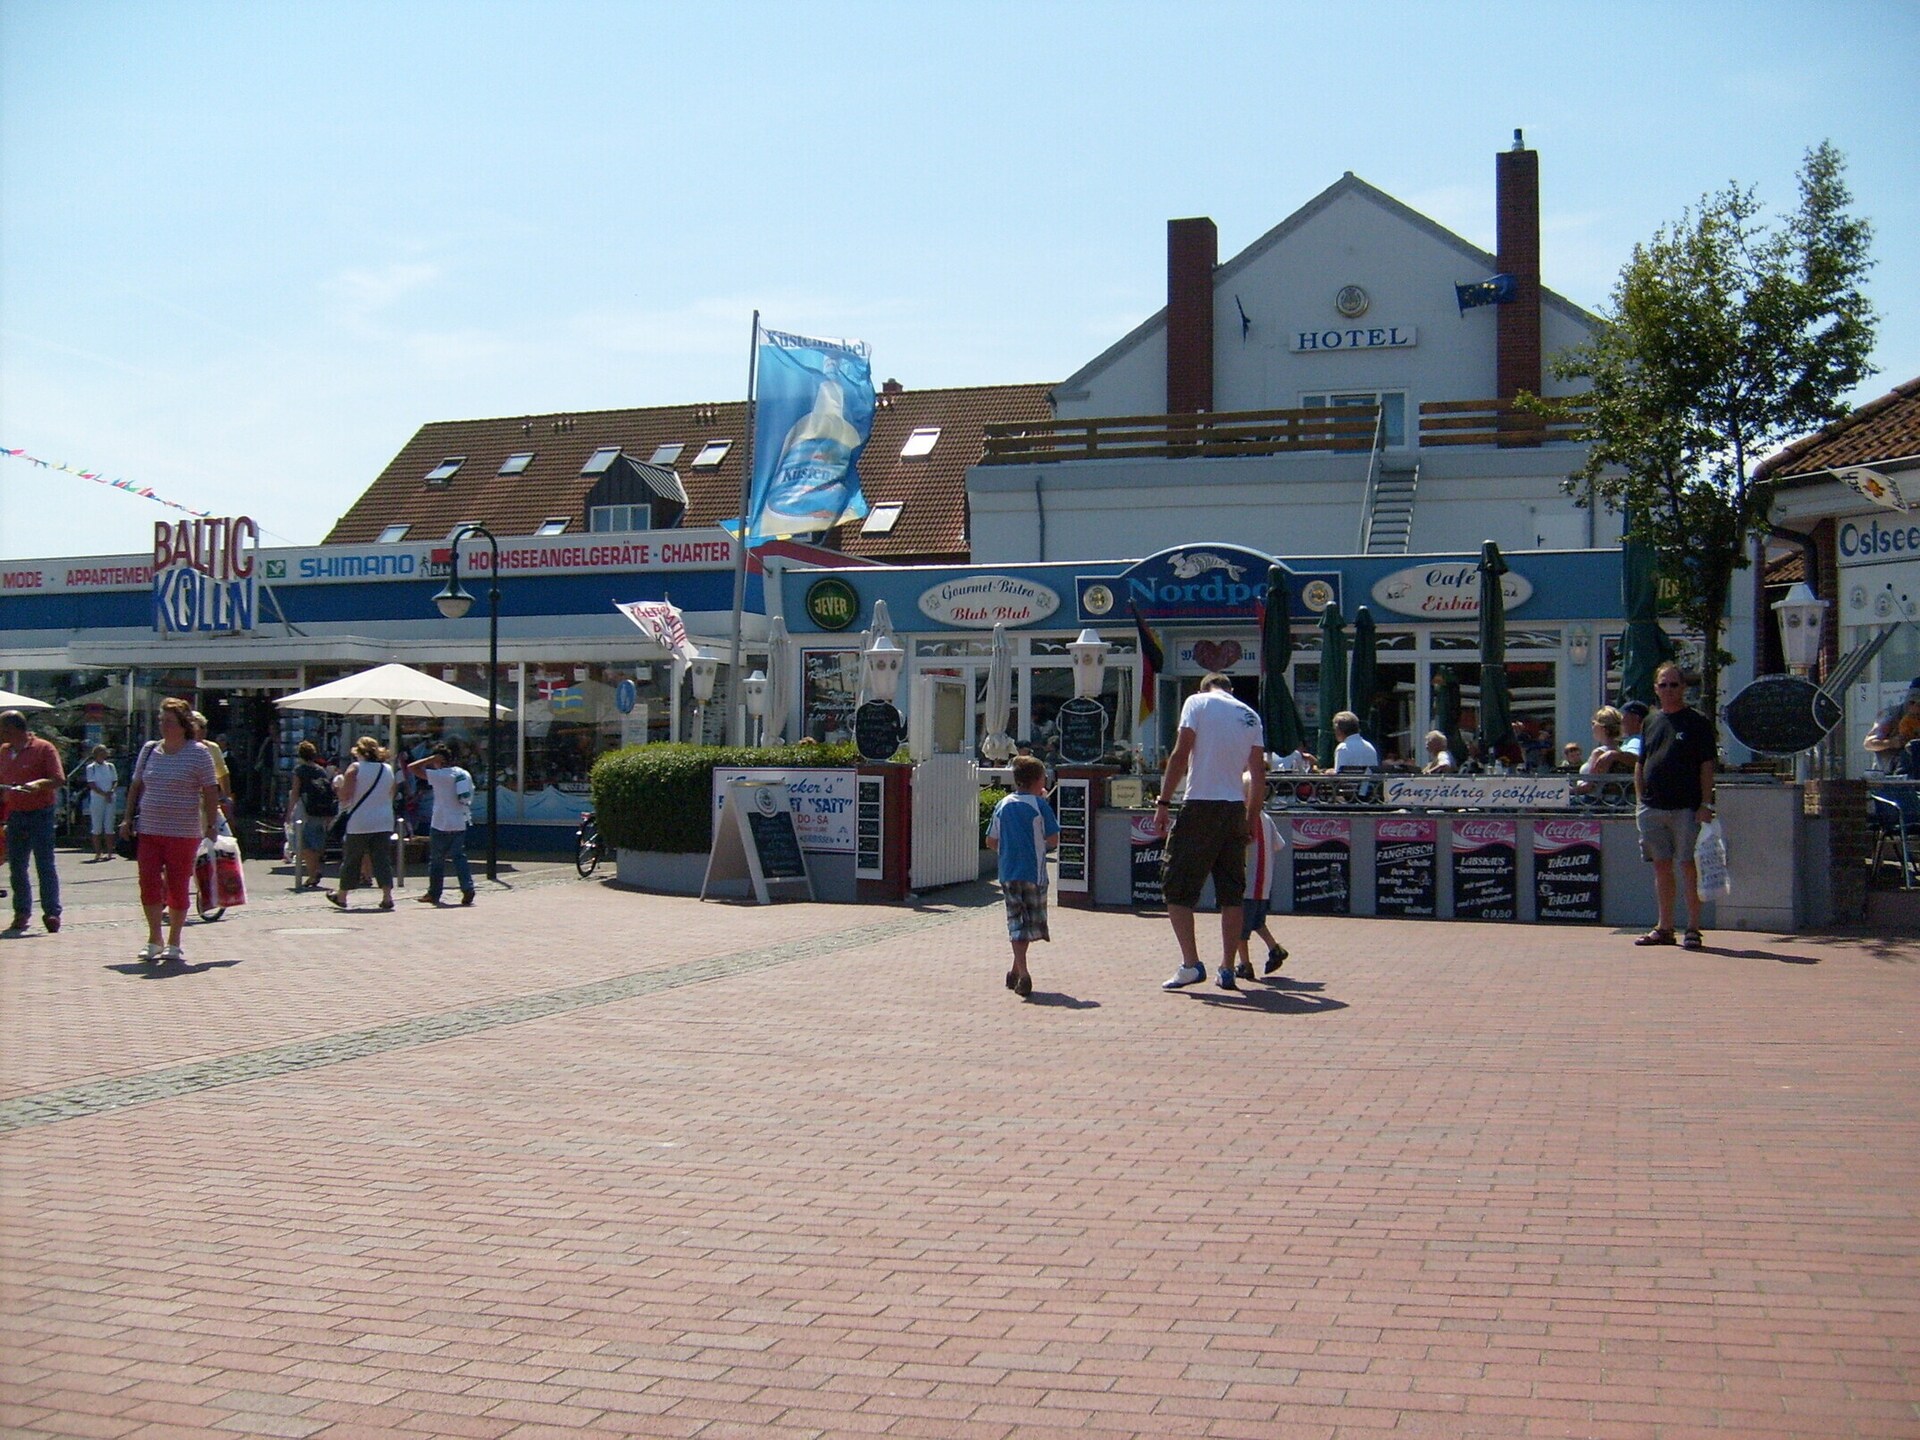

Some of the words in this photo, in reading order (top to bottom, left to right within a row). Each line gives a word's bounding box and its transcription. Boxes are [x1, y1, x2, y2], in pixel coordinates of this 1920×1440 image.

[1298, 327, 1408, 350] HOTEL
[153, 516, 255, 580] BALTIC
[468, 540, 650, 571] HOCHSEEANGELGERÄTE
[660, 541, 730, 564] CHARTER
[299, 554, 415, 578] SHIMANO
[2, 571, 43, 588] MODE
[1425, 567, 1477, 588] Café
[814, 597, 848, 616] JEVER
[950, 607, 988, 620] Blub
[991, 605, 1031, 619] Blub
[1388, 782, 1485, 801] Ganzjährig
[1491, 785, 1566, 803] geöffnet
[797, 814, 810, 823] DO
[816, 815, 829, 825] SA
[1376, 844, 1435, 861] FANGFRISCH
[1547, 853, 1591, 868] TÄGLICH
[1547, 891, 1591, 906] TÄGLICH
